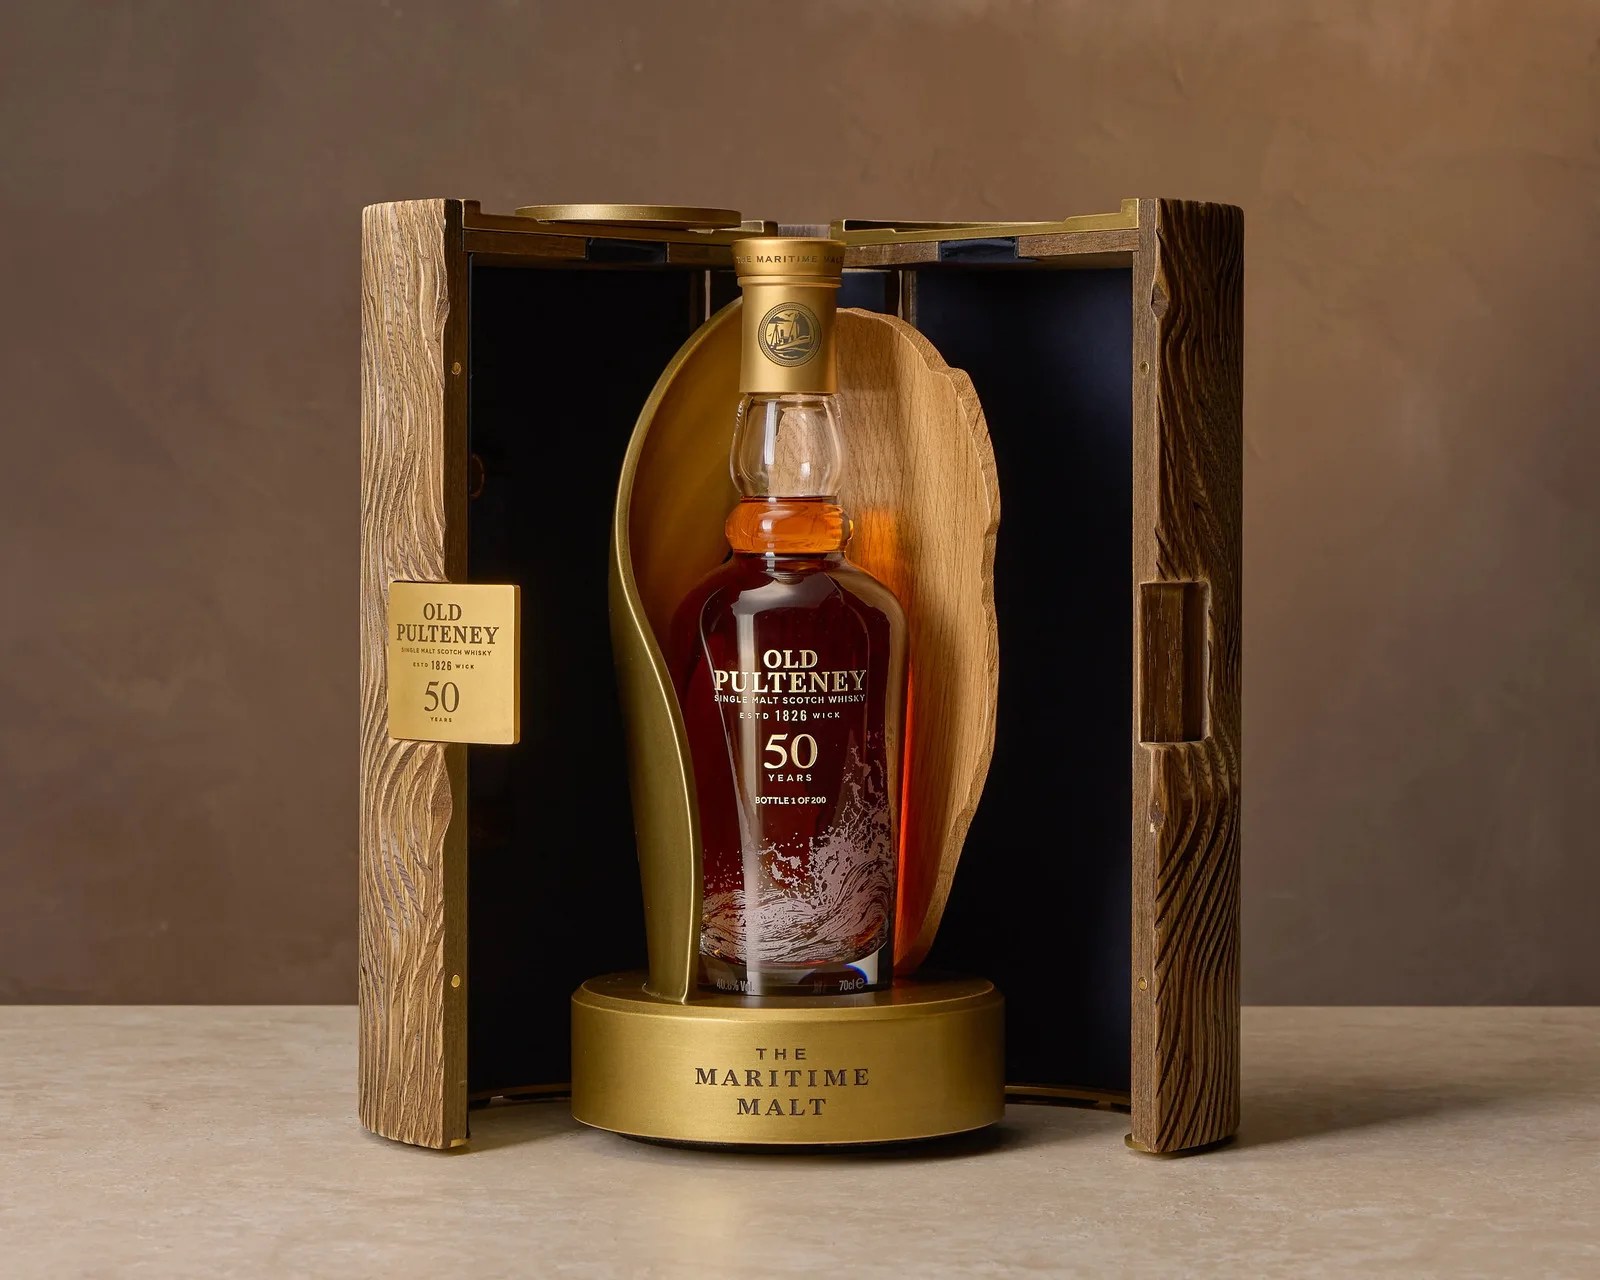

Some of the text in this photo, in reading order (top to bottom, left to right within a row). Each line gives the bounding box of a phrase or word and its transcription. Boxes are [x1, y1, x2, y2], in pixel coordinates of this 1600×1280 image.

[756, 255, 817, 263] MARITIME
[423, 602, 462, 621] OLD
[396, 624, 499, 645] PULTENEY
[431, 660, 452, 671] 1826
[763, 649, 818, 669] OLD
[714, 670, 867, 693] PULTENEY
[424, 681, 460, 713] 50
[714, 694, 866, 705] SINGLE MALT SCOTCH WHISKY
[739, 710, 840, 722] ESTD 1826 WICK
[763, 733, 818, 769] 50
[768, 773, 812, 782] YEARS
[755, 796, 827, 805] BOTTLE 1 OF 200
[839, 979, 855, 991] 70cl
[756, 1048, 807, 1060] THE
[694, 1067, 869, 1088] MARITIME
[736, 1098, 827, 1116] MALT
